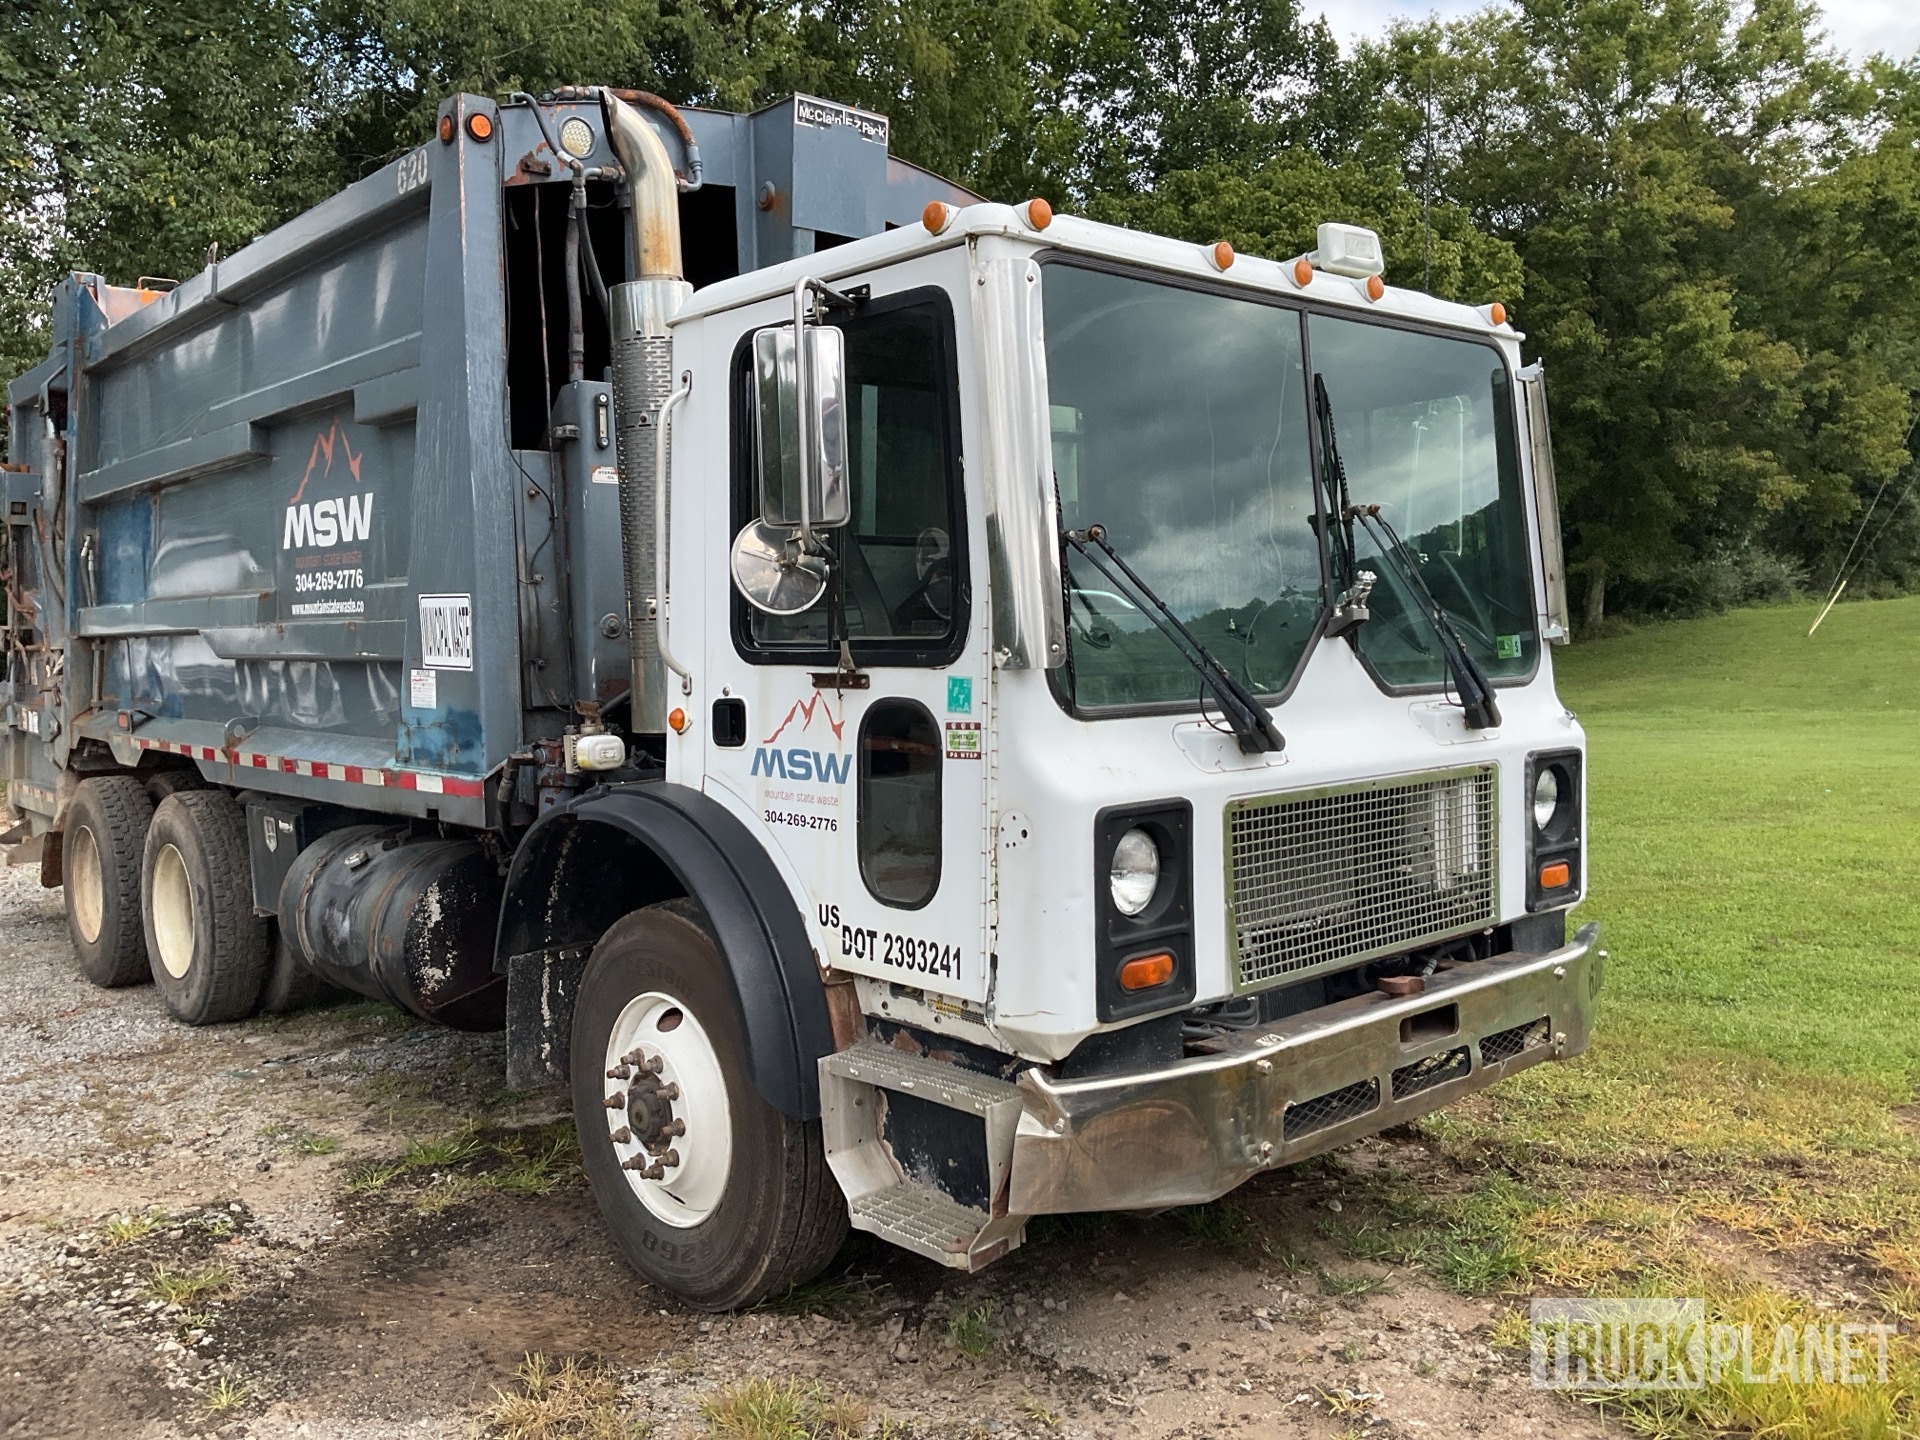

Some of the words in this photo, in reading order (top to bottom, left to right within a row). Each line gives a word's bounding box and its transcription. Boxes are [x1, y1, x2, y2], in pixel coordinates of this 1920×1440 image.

[398, 149, 428, 194] 620
[283, 492, 373, 550] MSW
[295, 568, 364, 592] 304-269-2776
[750, 747, 853, 785] MSW
[764, 809, 838, 832] 304-269-2776
[818, 903, 840, 928] US
[842, 924, 878, 961] DOT
[883, 932, 961, 980] 2393241
